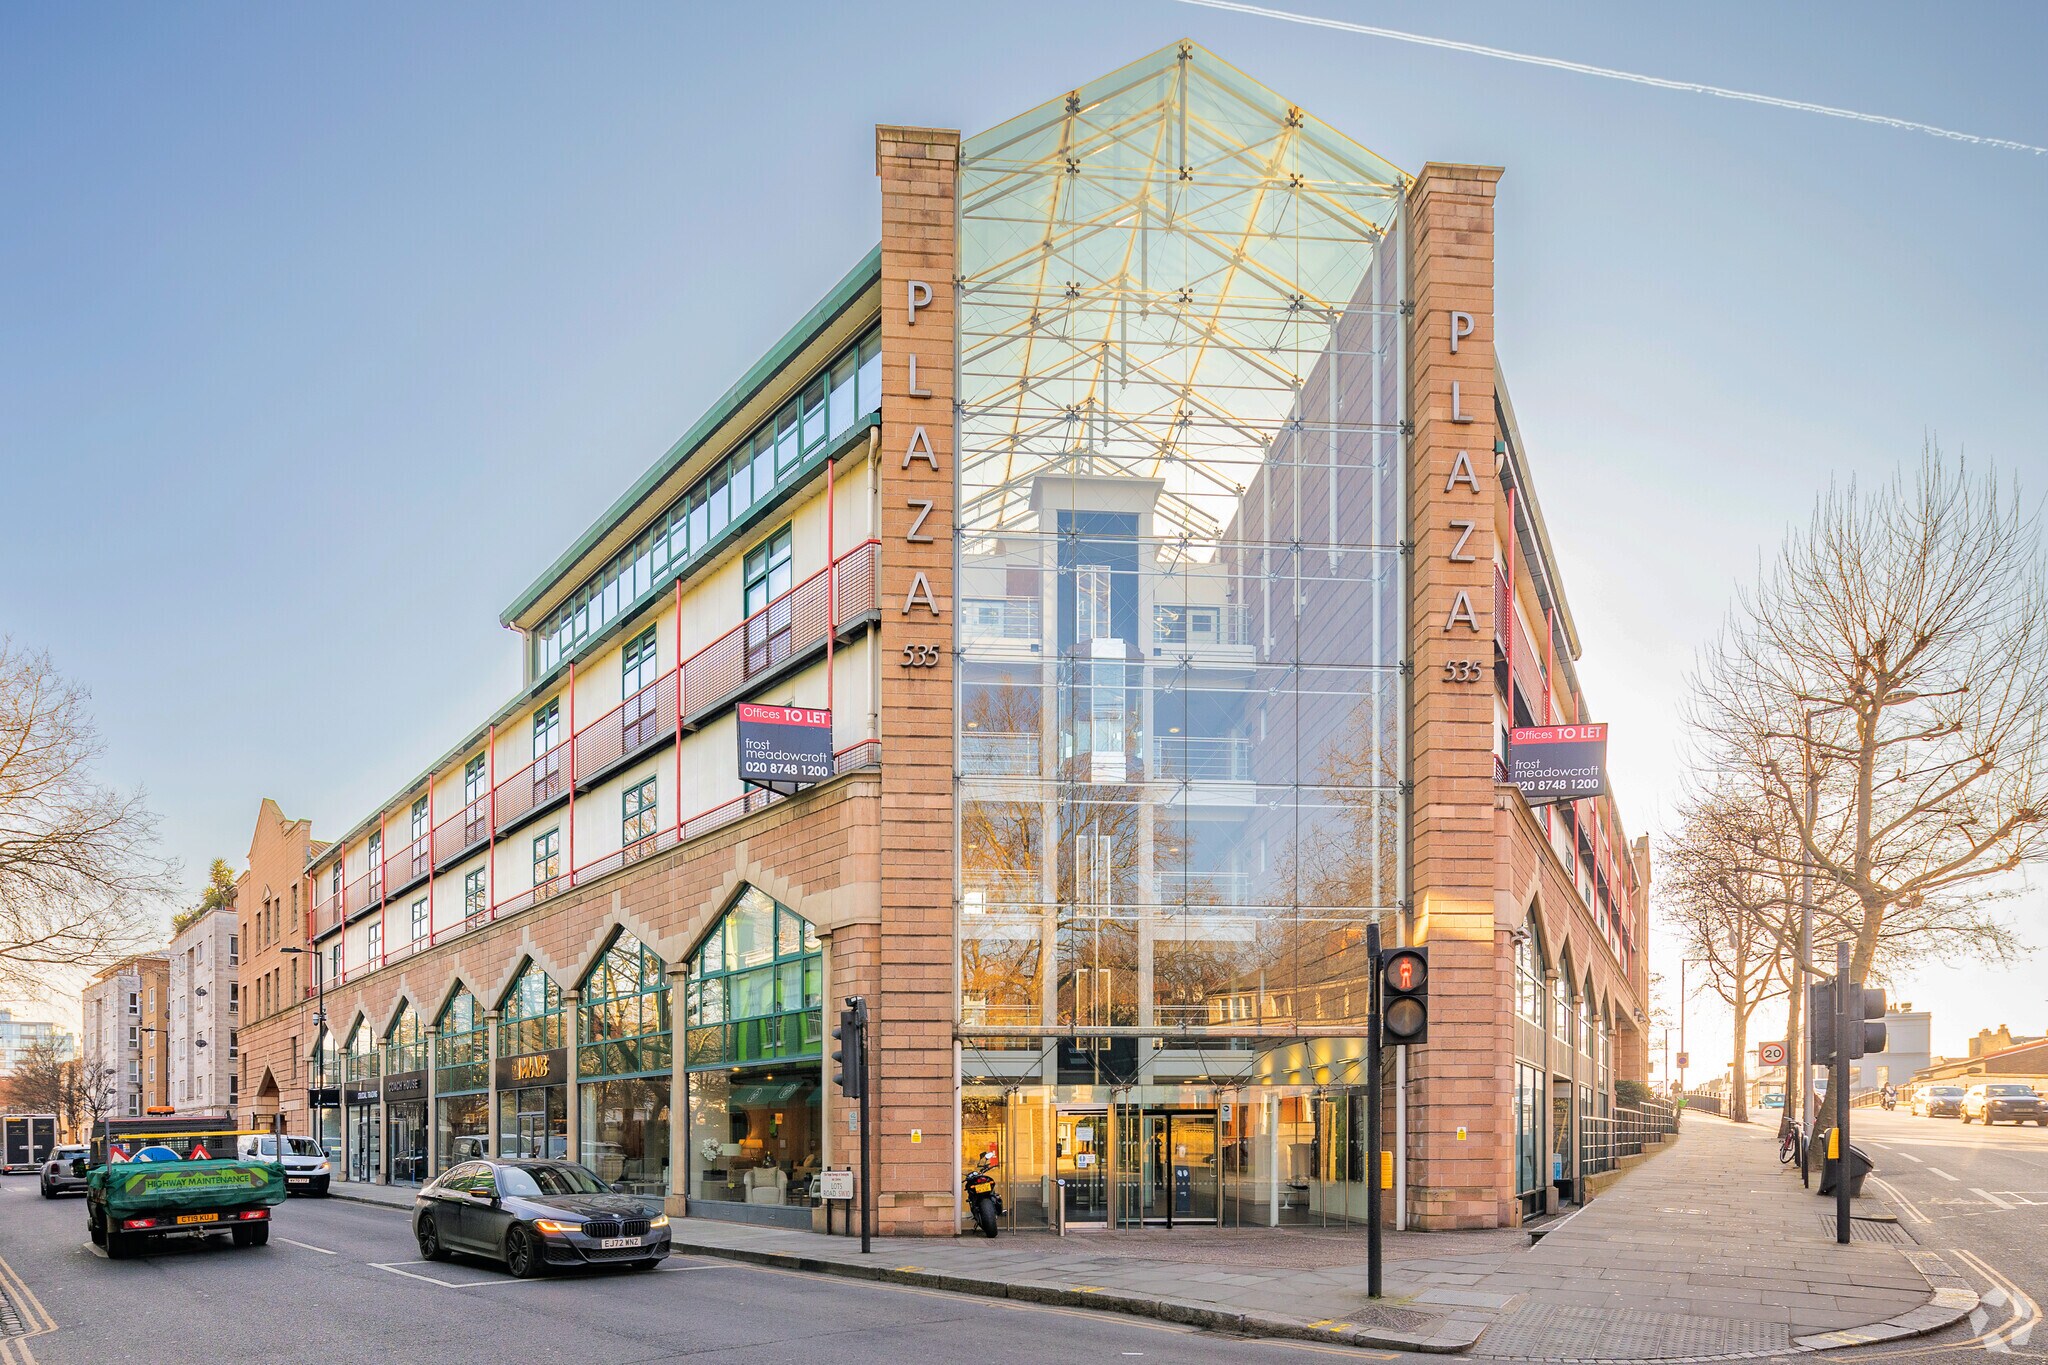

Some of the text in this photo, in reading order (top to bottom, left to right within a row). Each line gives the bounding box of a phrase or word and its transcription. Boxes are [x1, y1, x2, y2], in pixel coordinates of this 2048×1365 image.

[902, 280, 939, 616] PLAZA
[1443, 310, 1481, 633] PLAZA
[901, 644, 940, 668] 535
[1442, 659, 1482, 683] 535
[743, 707, 827, 724] Offices TO LET
[1516, 726, 1602, 740] Offices TO LET
[745, 738, 771, 750] frost
[745, 750, 828, 763] meadowcroft
[745, 761, 828, 777] 020 8748 1200
[1515, 759, 1541, 770] frost
[1514, 765, 1600, 778] meadowcroft
[1537, 780, 1567, 791] 8748
[1571, 778, 1599, 790] 1200
[1764, 1049, 1782, 1058] 20
[403, 1079, 418, 1091] HOUSE
[147, 1178, 187, 1188] HIGHWAY
[188, 1174, 249, 1186] MAINTENANCE
[830, 1182, 843, 1190] LOTS
[604, 1238, 639, 1247] EJ72 WNZ
